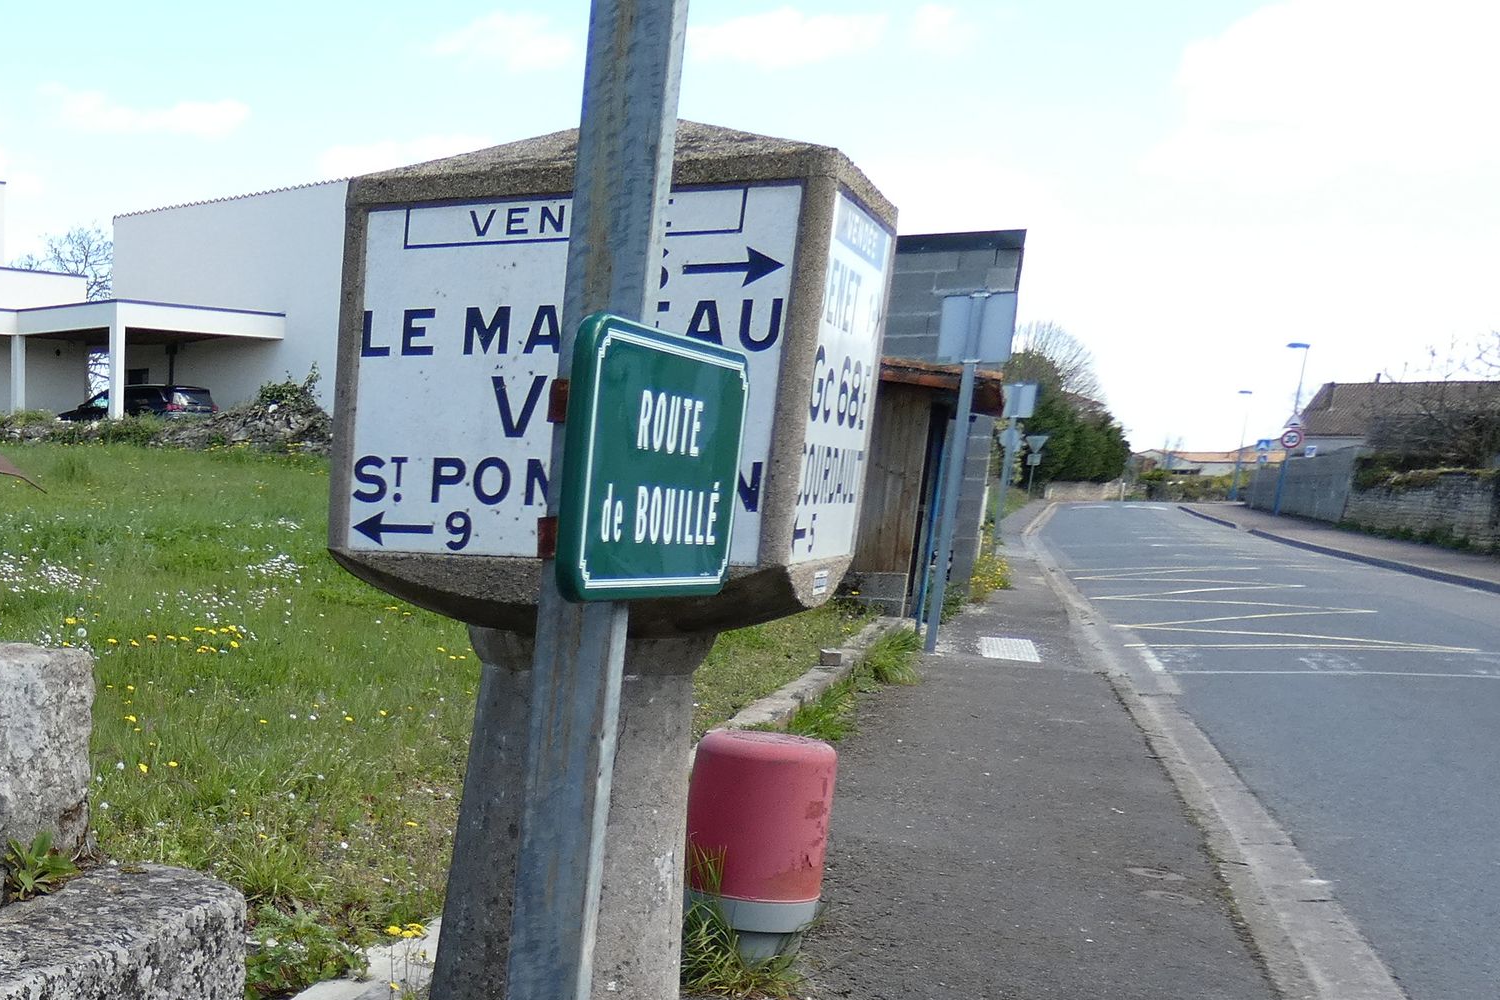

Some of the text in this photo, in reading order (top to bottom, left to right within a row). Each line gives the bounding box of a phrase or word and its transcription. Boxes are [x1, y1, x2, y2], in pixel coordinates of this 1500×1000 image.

[361, 298, 784, 357] LE MAAU
[637, 389, 704, 457] ROUTE
[445, 511, 472, 551] 9
[600, 481, 721, 546] de BOUILLÉ
